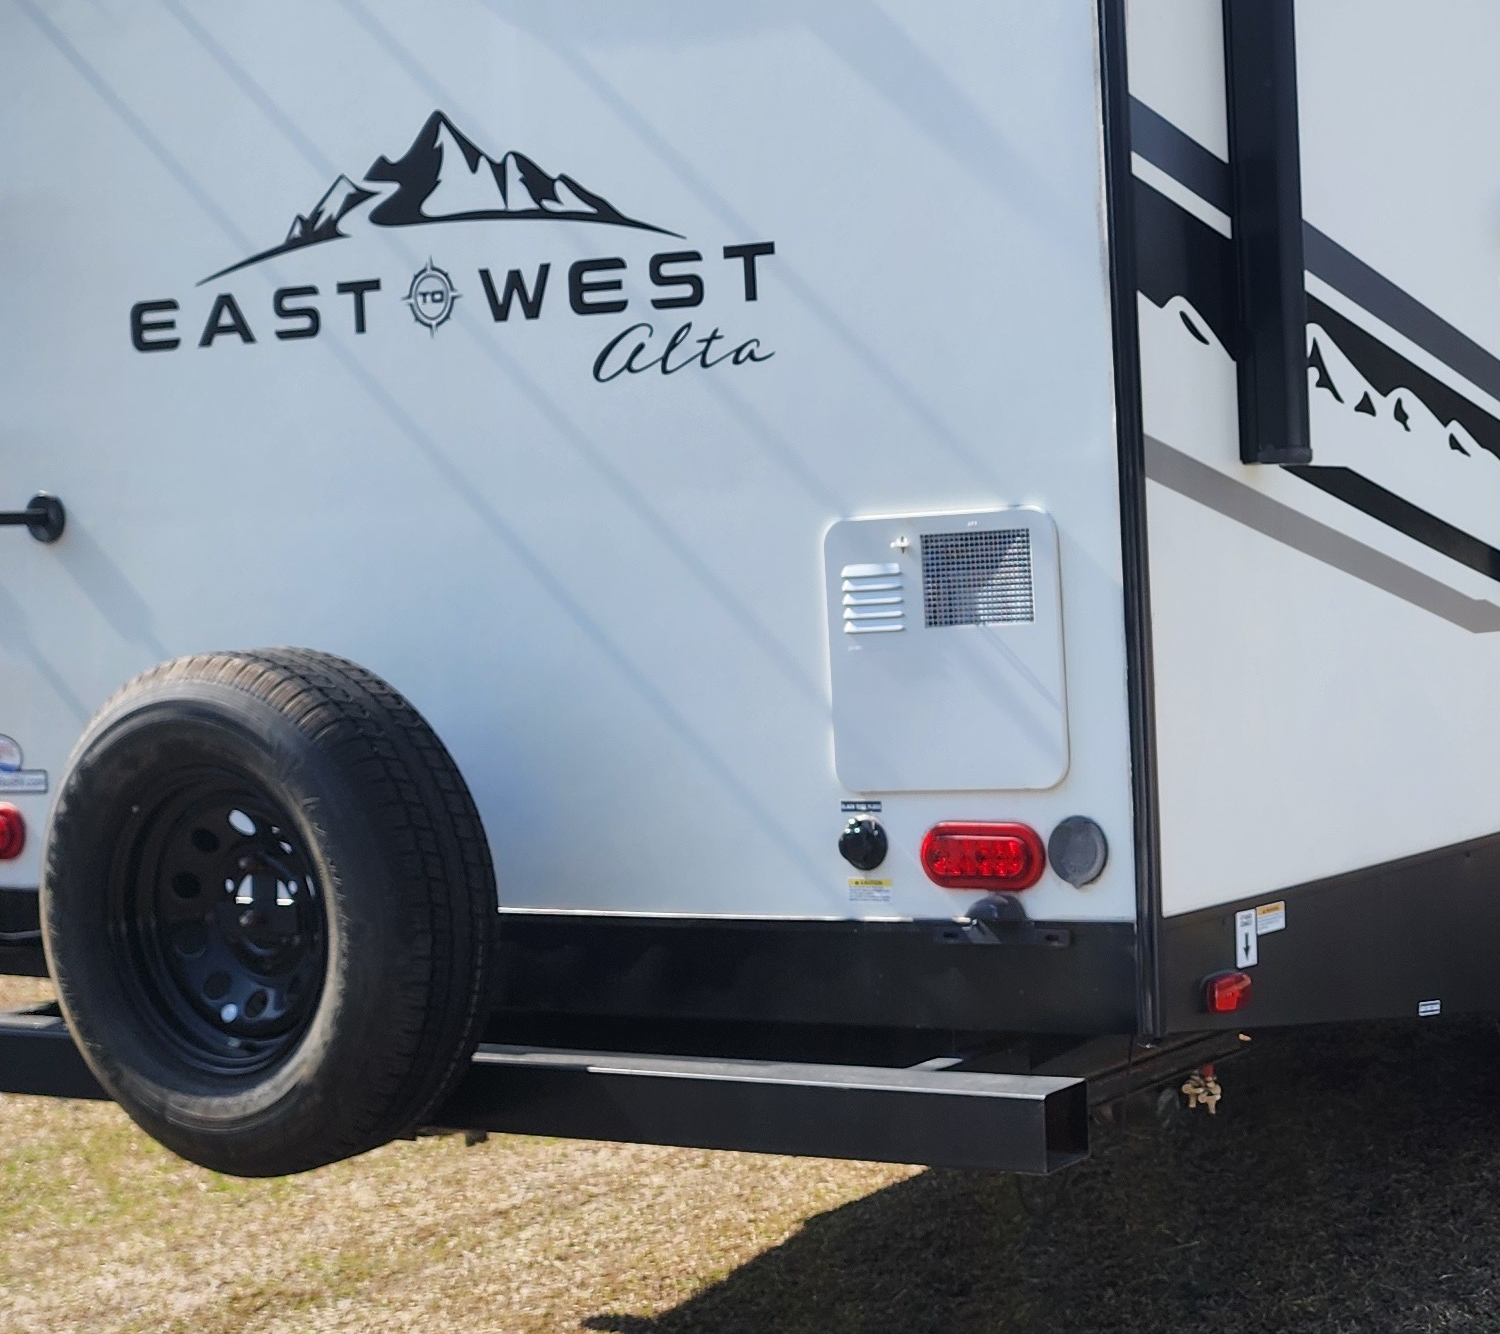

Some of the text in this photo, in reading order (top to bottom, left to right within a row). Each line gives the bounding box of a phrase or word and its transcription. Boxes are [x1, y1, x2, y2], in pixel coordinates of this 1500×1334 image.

[130, 241, 775, 353] EAST TO WEST
[593, 322, 774, 382] Alta
